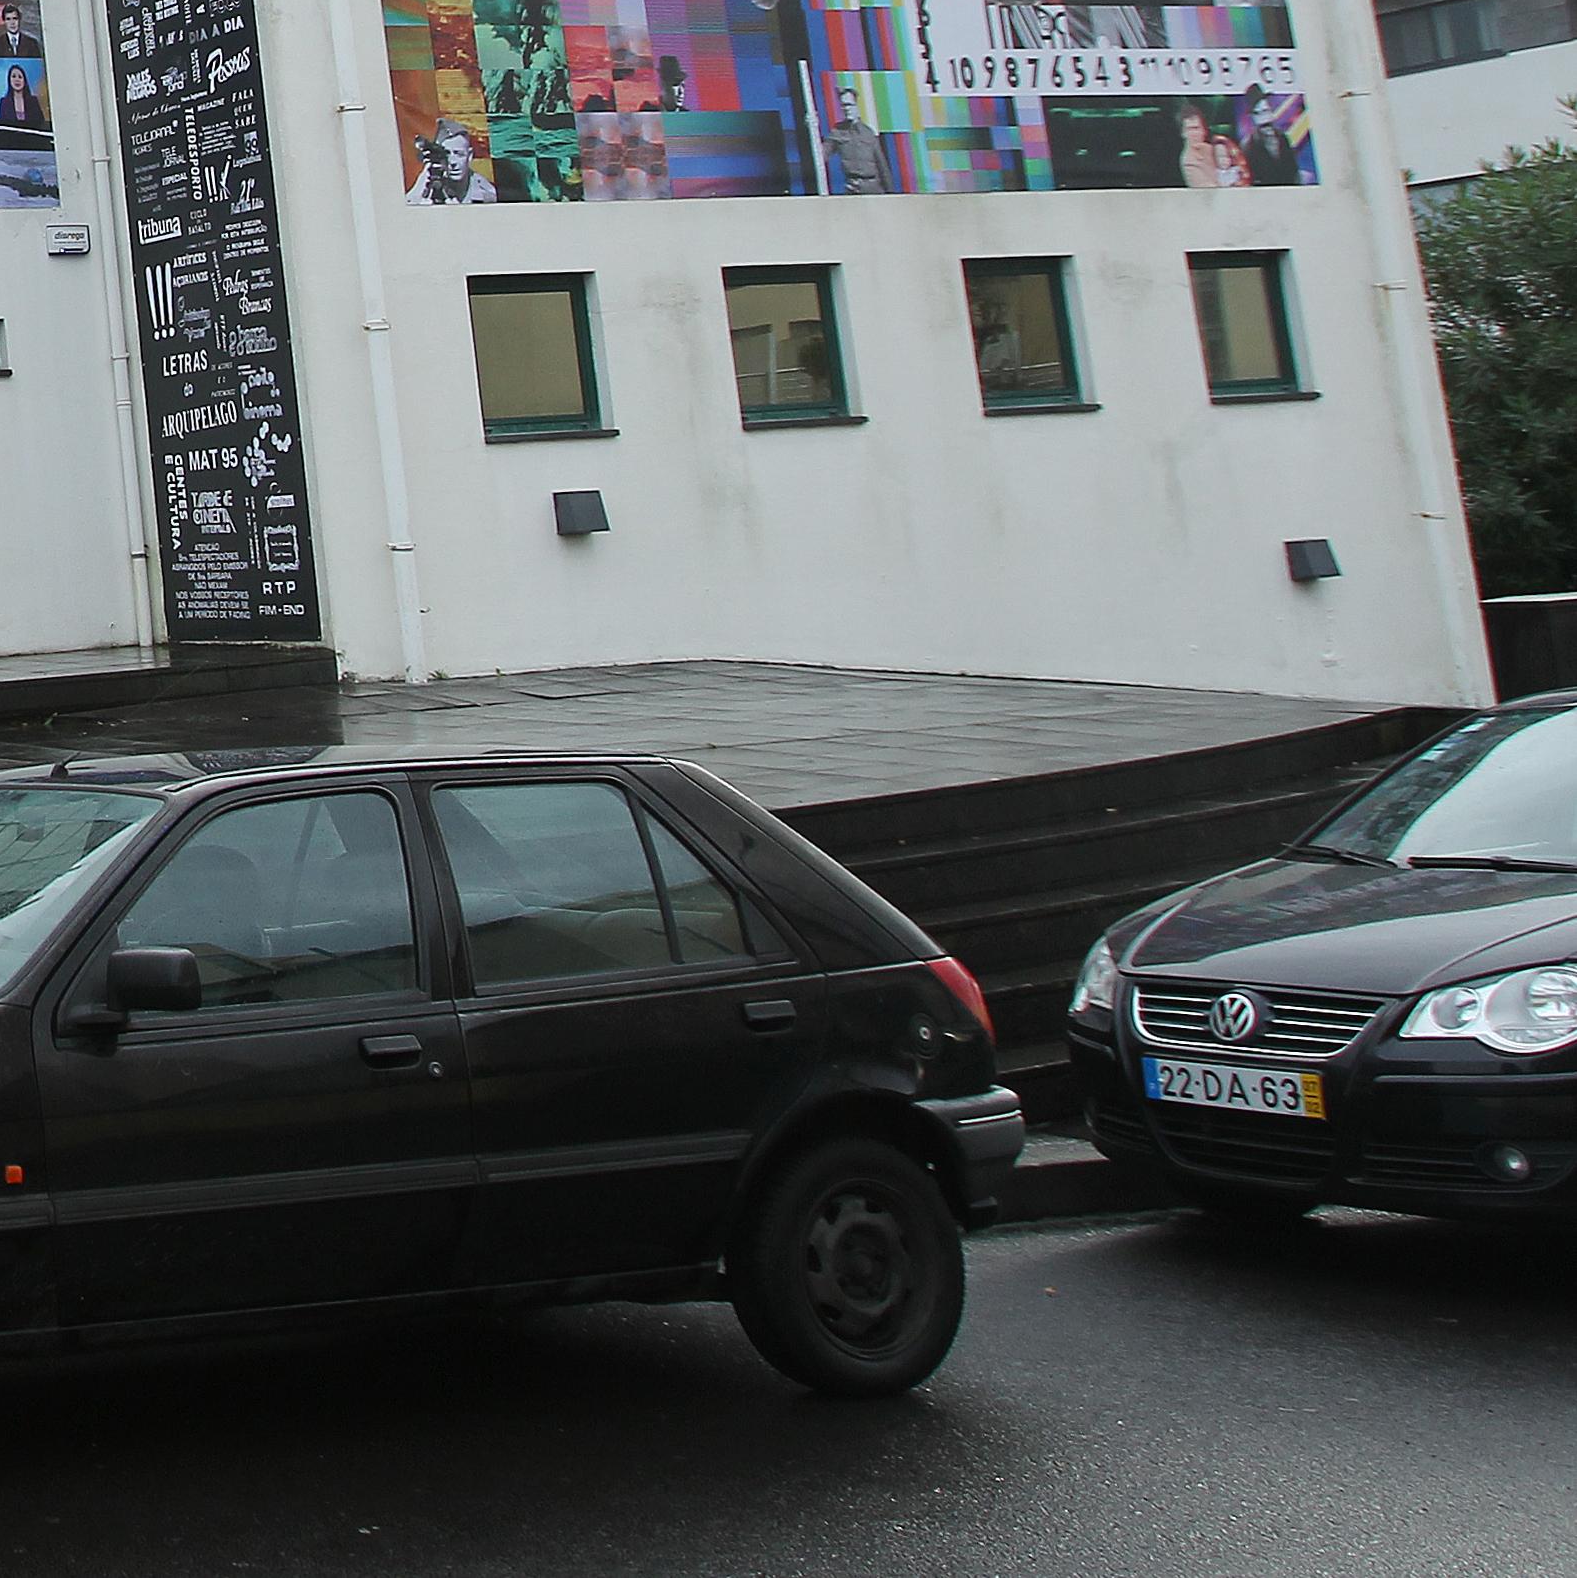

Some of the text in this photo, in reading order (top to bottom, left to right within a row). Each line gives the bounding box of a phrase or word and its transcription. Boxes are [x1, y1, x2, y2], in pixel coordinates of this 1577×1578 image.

[223, 15, 245, 34] DIA
[984, 55, 997, 89] 9
[1005, 56, 1020, 88] 8
[1027, 57, 1042, 89] 7
[1052, 54, 1064, 88] 6
[1072, 55, 1086, 88] 5
[1118, 55, 1132, 88] 3
[184, 107, 204, 201] TELEDESPORTO
[137, 216, 182, 240] tribuna
[162, 349, 208, 377] LETRAS
[188, 447, 239, 472] MAT 95
[166, 472, 182, 551] CULTURA
